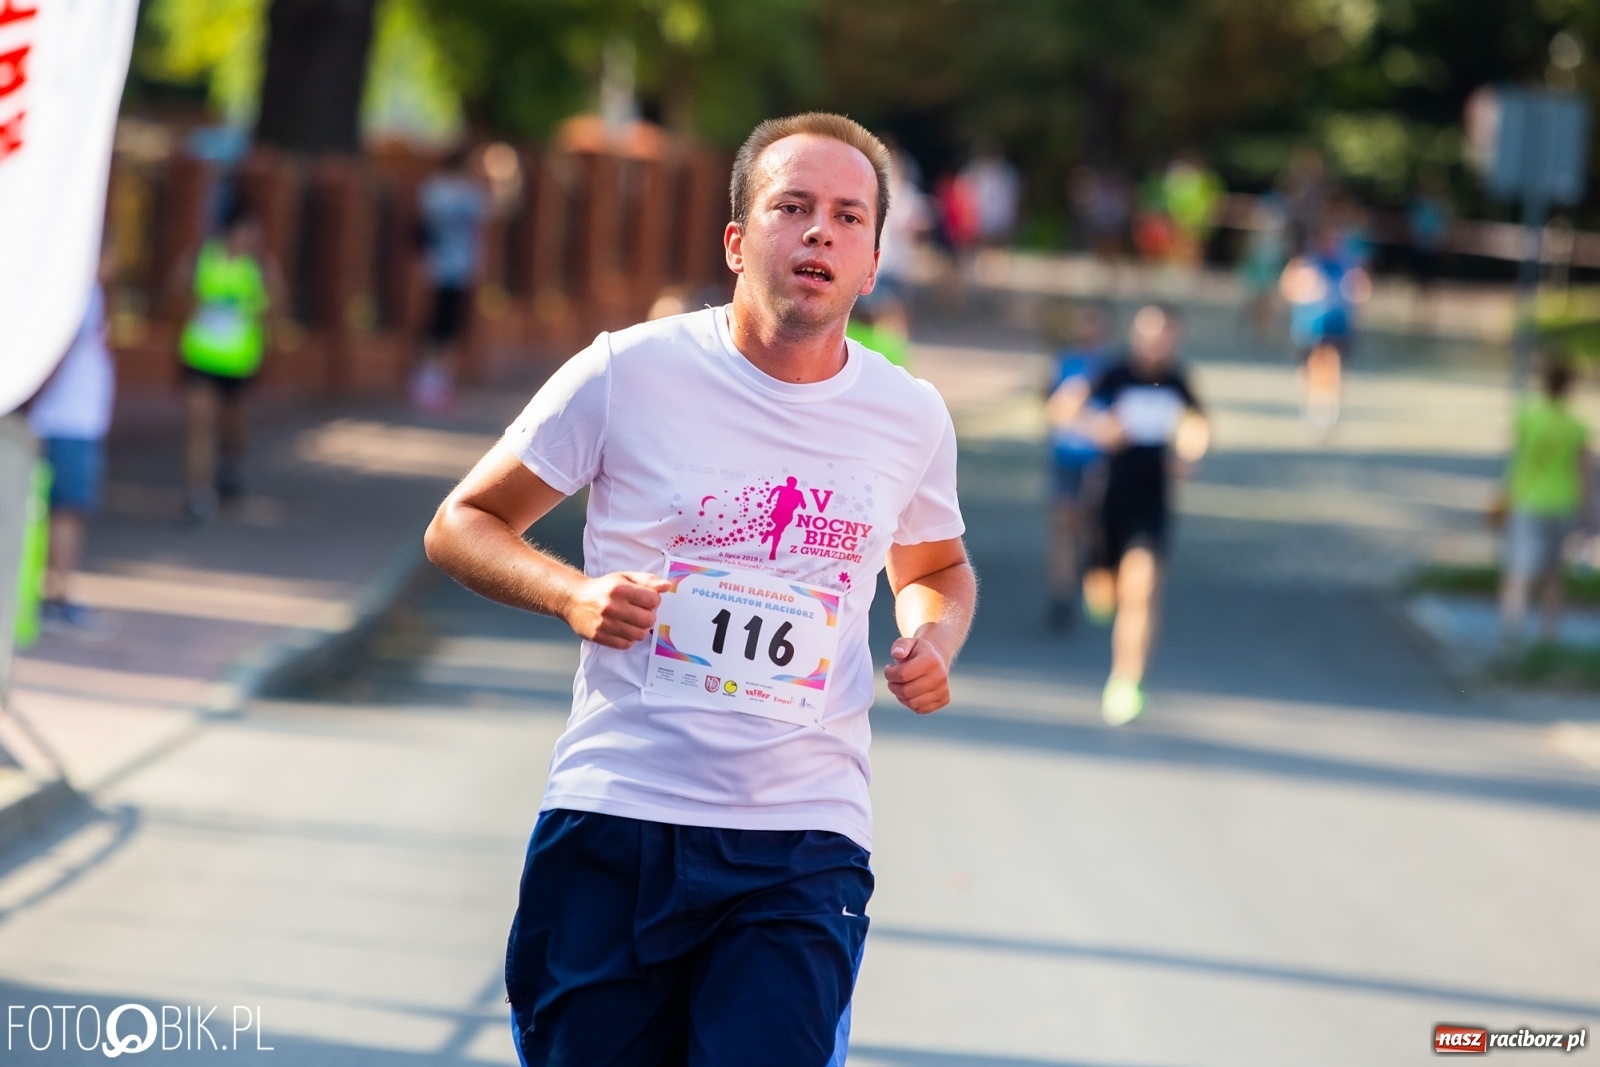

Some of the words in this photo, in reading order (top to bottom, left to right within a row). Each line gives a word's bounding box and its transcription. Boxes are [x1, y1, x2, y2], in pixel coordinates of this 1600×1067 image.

[810, 488, 833, 513] V
[796, 514, 873, 539] NOCNY
[804, 530, 858, 552] BIEG
[725, 552, 740, 560] lipca
[742, 554, 758, 563] 2019
[790, 545, 798, 554] Z
[800, 547, 862, 564] GWIAZDAMI
[718, 581, 745, 593] MINI
[748, 587, 795, 603] RAFAKO
[711, 608, 795, 667] 116
